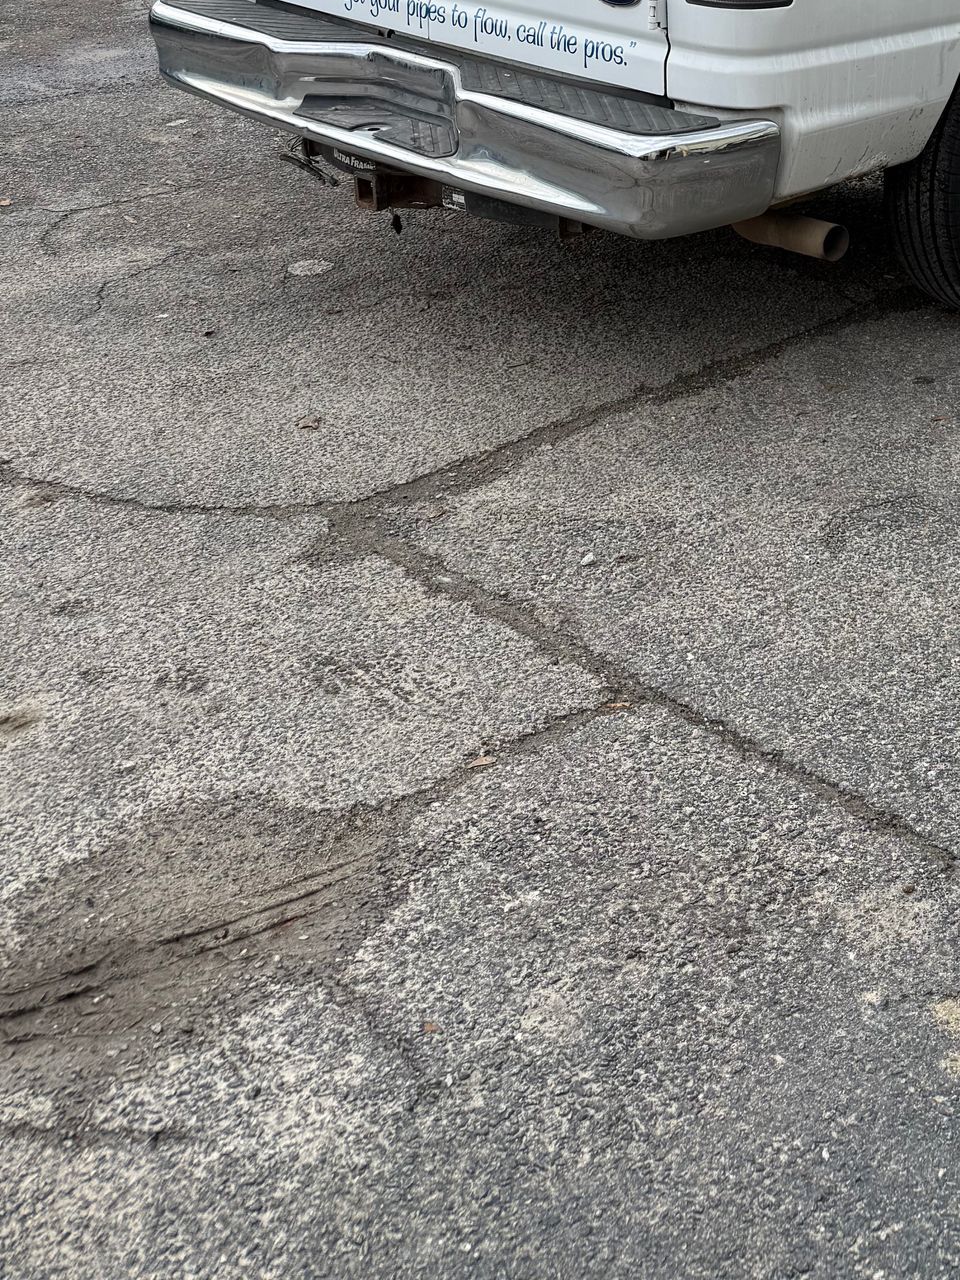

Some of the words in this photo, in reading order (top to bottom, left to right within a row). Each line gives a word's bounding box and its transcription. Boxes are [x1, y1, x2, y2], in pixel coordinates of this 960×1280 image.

[452, 4, 468, 28] to
[474, 8, 511, 42] flow,
[516, 21, 547, 48] call
[550, 26, 578, 54] the
[584, 38, 637, 68] pros."
